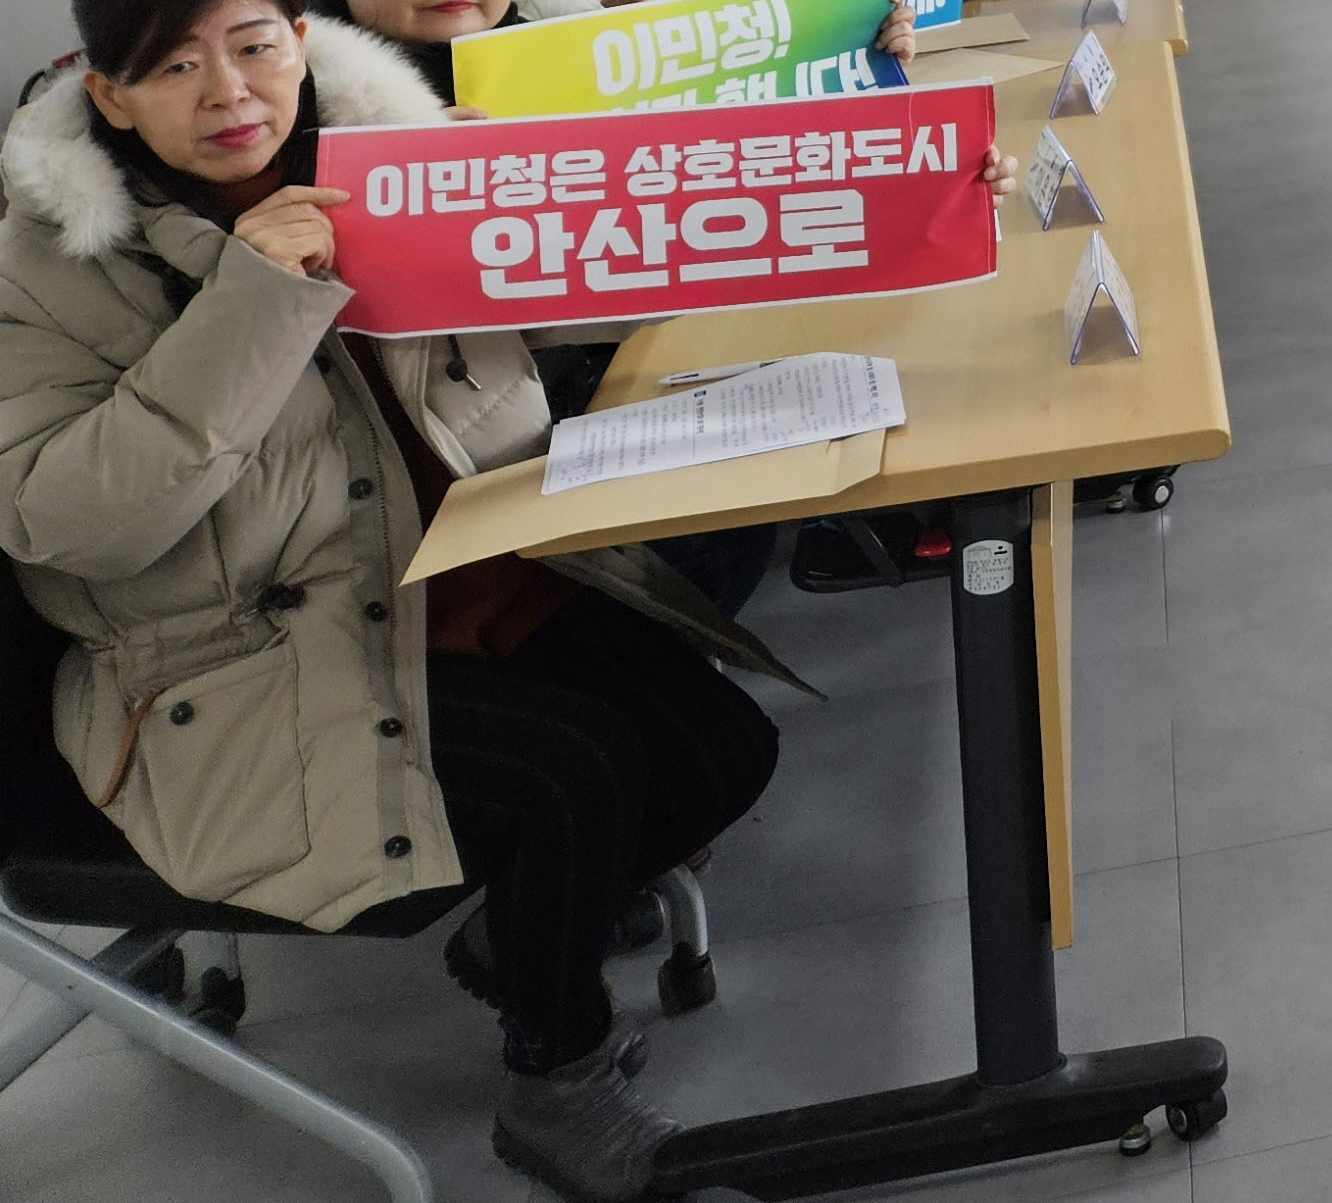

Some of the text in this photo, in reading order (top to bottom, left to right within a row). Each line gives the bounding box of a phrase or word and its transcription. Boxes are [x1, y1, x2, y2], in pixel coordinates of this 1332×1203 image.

[365, 146, 608, 218] 이민청은
[623, 121, 959, 199] 상호문화도시
[470, 188, 870, 300] 안산으로
